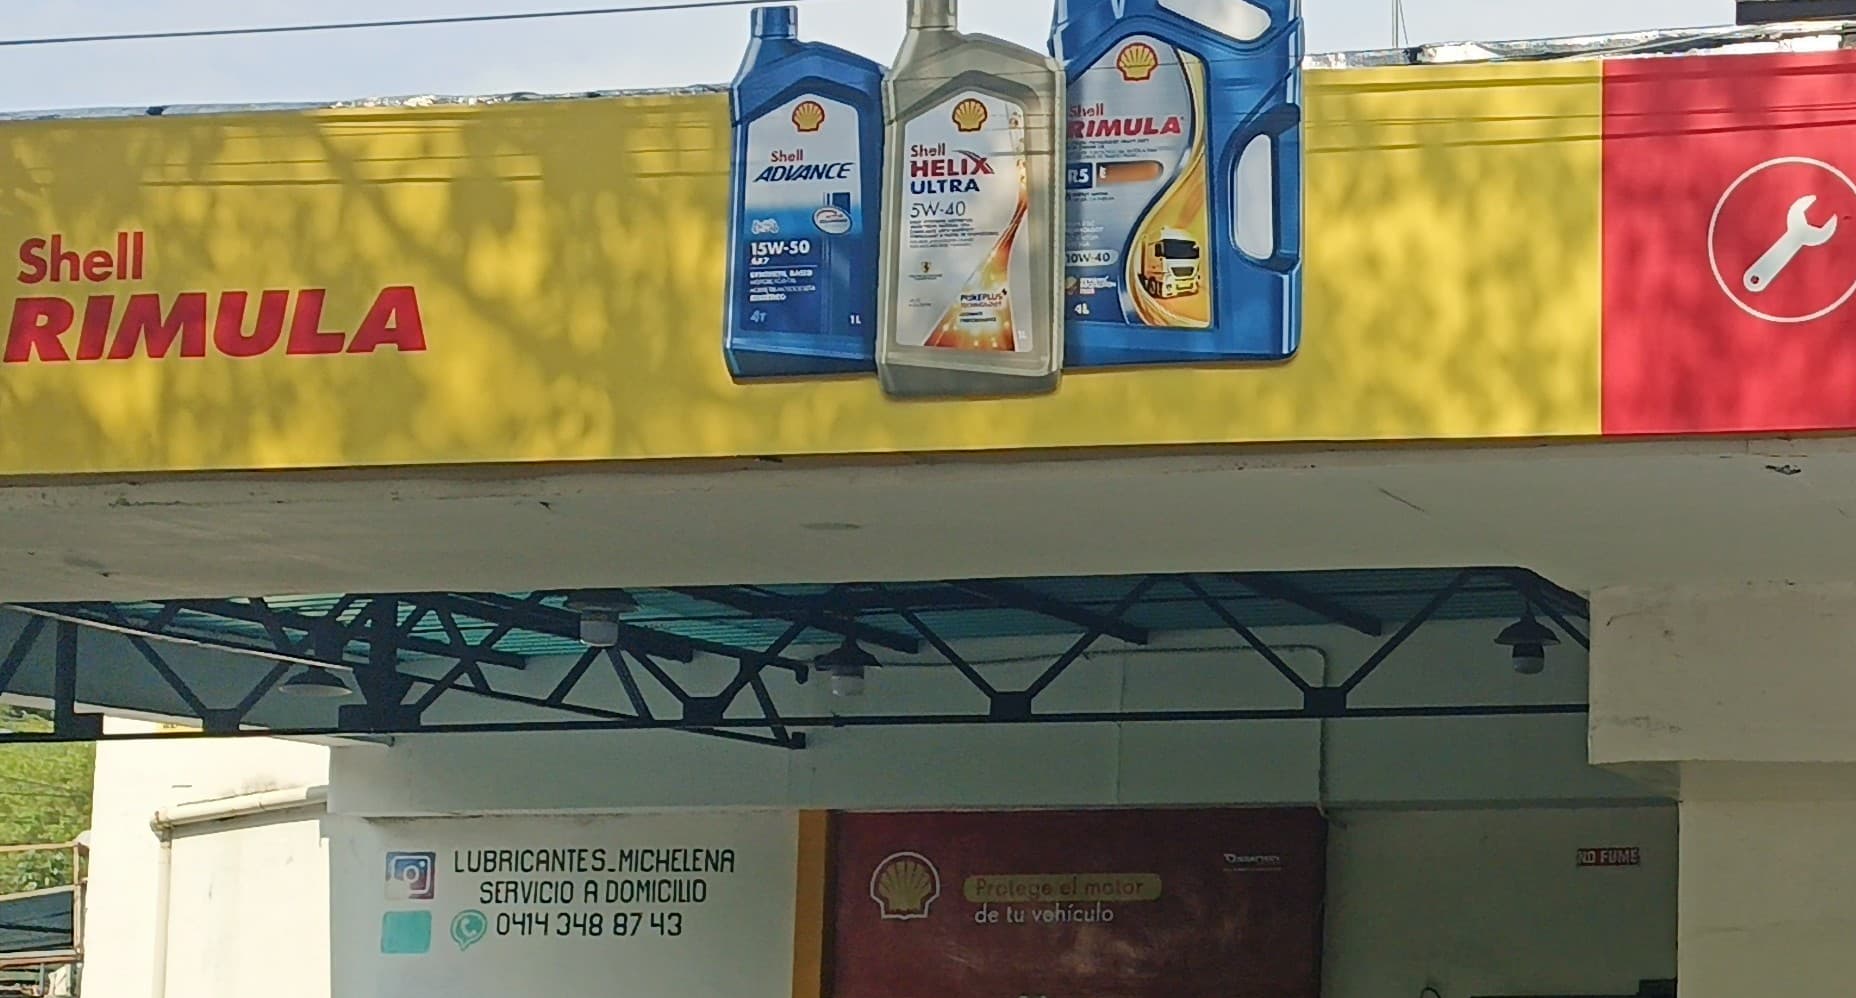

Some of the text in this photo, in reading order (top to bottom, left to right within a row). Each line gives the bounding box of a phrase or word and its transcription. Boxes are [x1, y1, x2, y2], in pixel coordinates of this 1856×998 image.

[1067, 116, 1181, 138] RIMULA
[771, 149, 803, 162] Shell
[910, 143, 946, 157] Shell
[753, 162, 854, 182] ADVANCE
[910, 153, 995, 177] HELIX
[910, 178, 981, 195] ULTRA
[909, 200, 967, 218] 5W-40
[17, 231, 144, 284] Shell
[750, 240, 811, 255] 15W-50
[3, 286, 427, 363] RIMULA
[454, 848, 735, 874] LUBRICANTES_MICHELENA
[479, 878, 708, 905] SERVICIO A DOMICILIO
[975, 876, 1144, 898] Protege el motor
[974, 900, 1114, 923] de tu vehículo
[496, 911, 683, 937] 0414 348 87 43
